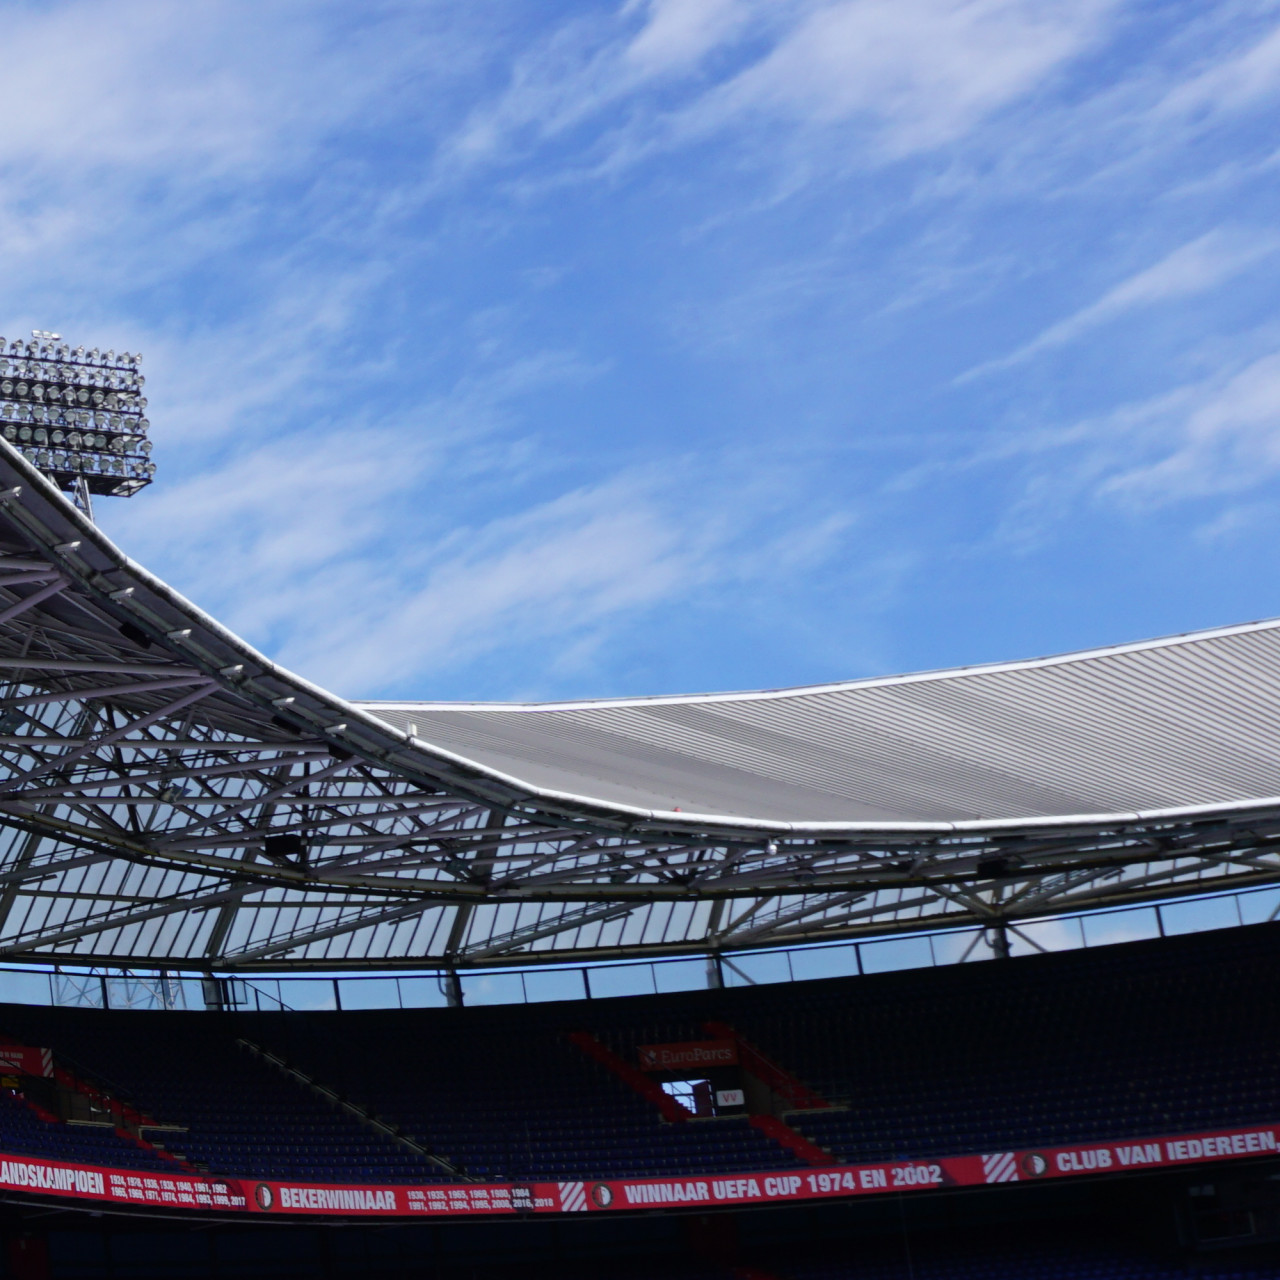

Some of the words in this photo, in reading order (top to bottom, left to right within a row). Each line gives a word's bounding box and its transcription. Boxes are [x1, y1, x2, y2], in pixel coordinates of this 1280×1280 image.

[661, 1048, 732, 1064] EuroParcs
[1056, 1149, 1112, 1172] CLUB
[1116, 1143, 1162, 1165] VAN
[623, 1182, 710, 1204] WINNAAR
[712, 1179, 761, 1199] UEFA
[764, 1176, 803, 1197] CUP
[807, 1171, 855, 1193] 1974
[859, 1168, 887, 1189] EN
[891, 1164, 943, 1187] 2002
[280, 1187, 397, 1210] BEKERWINNAAR
